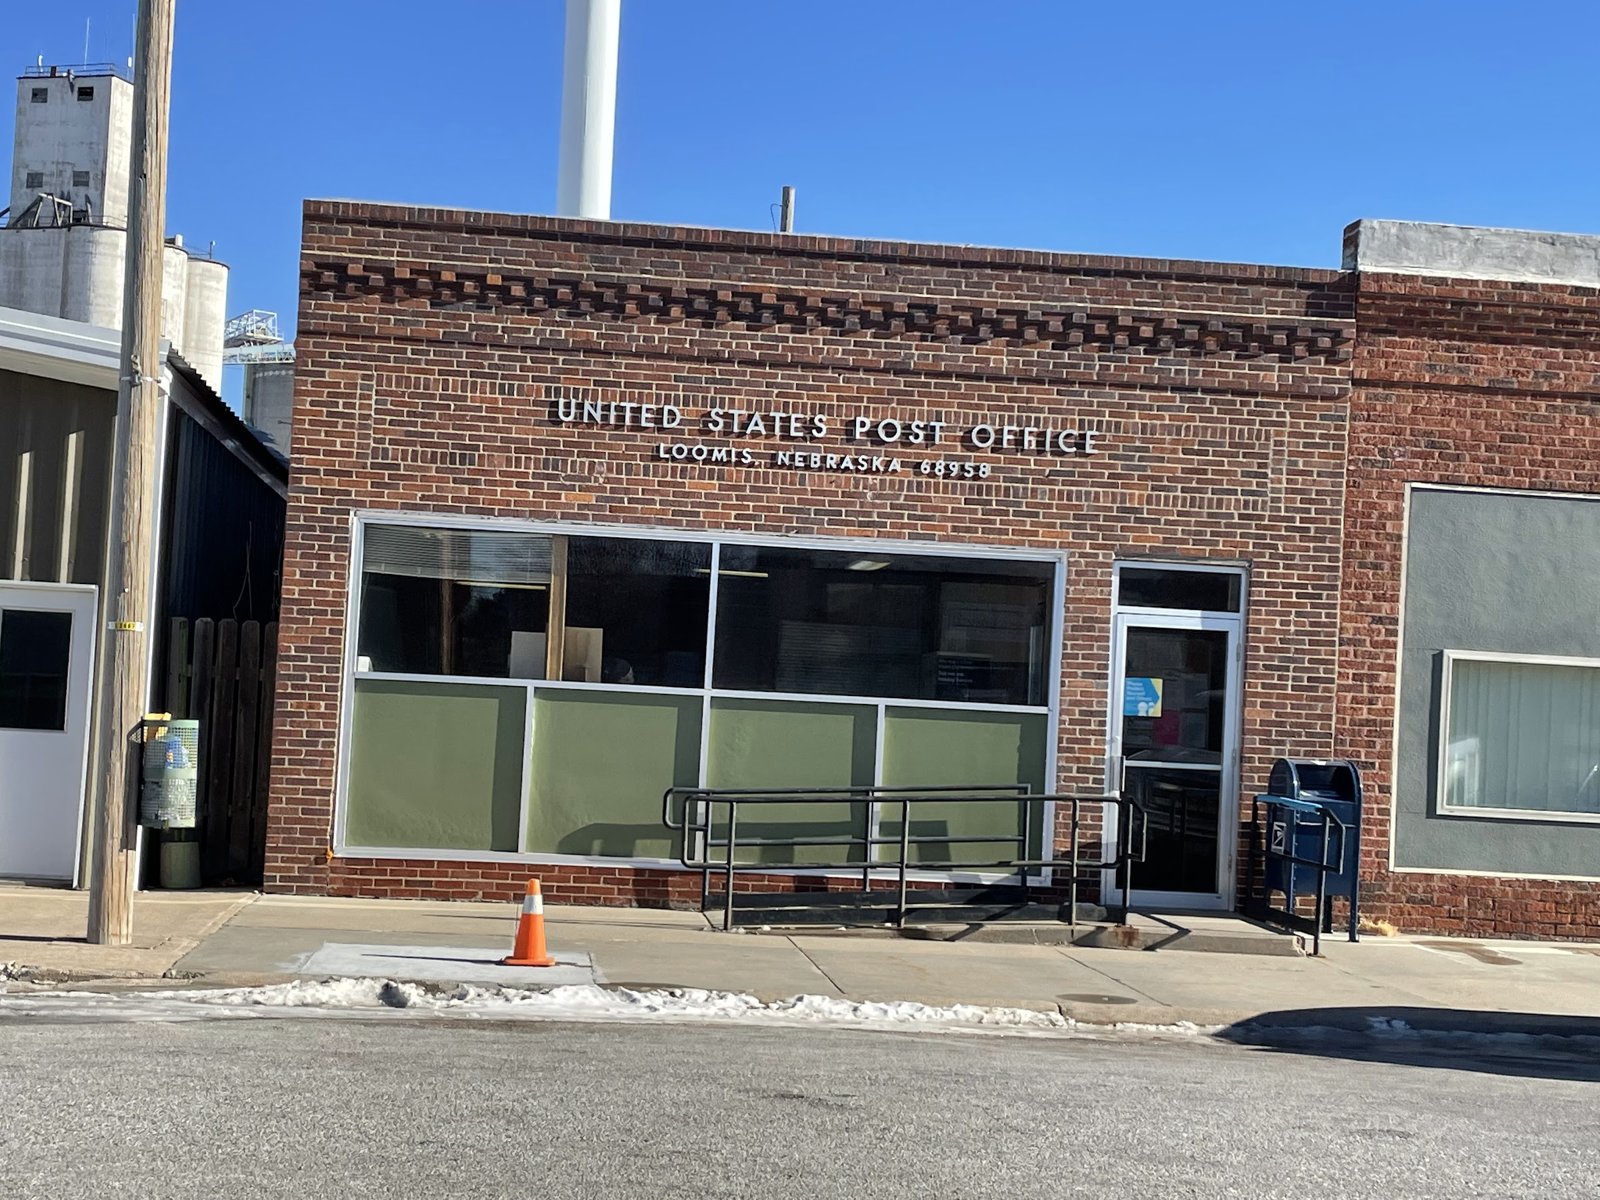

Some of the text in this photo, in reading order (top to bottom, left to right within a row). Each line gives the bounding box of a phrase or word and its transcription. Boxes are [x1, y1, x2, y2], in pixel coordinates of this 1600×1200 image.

[557, 398, 1100, 454] UNITED STATES POST OFFICE
[777, 451, 901, 473] NEBRASKA
[919, 458, 991, 479] 68958
